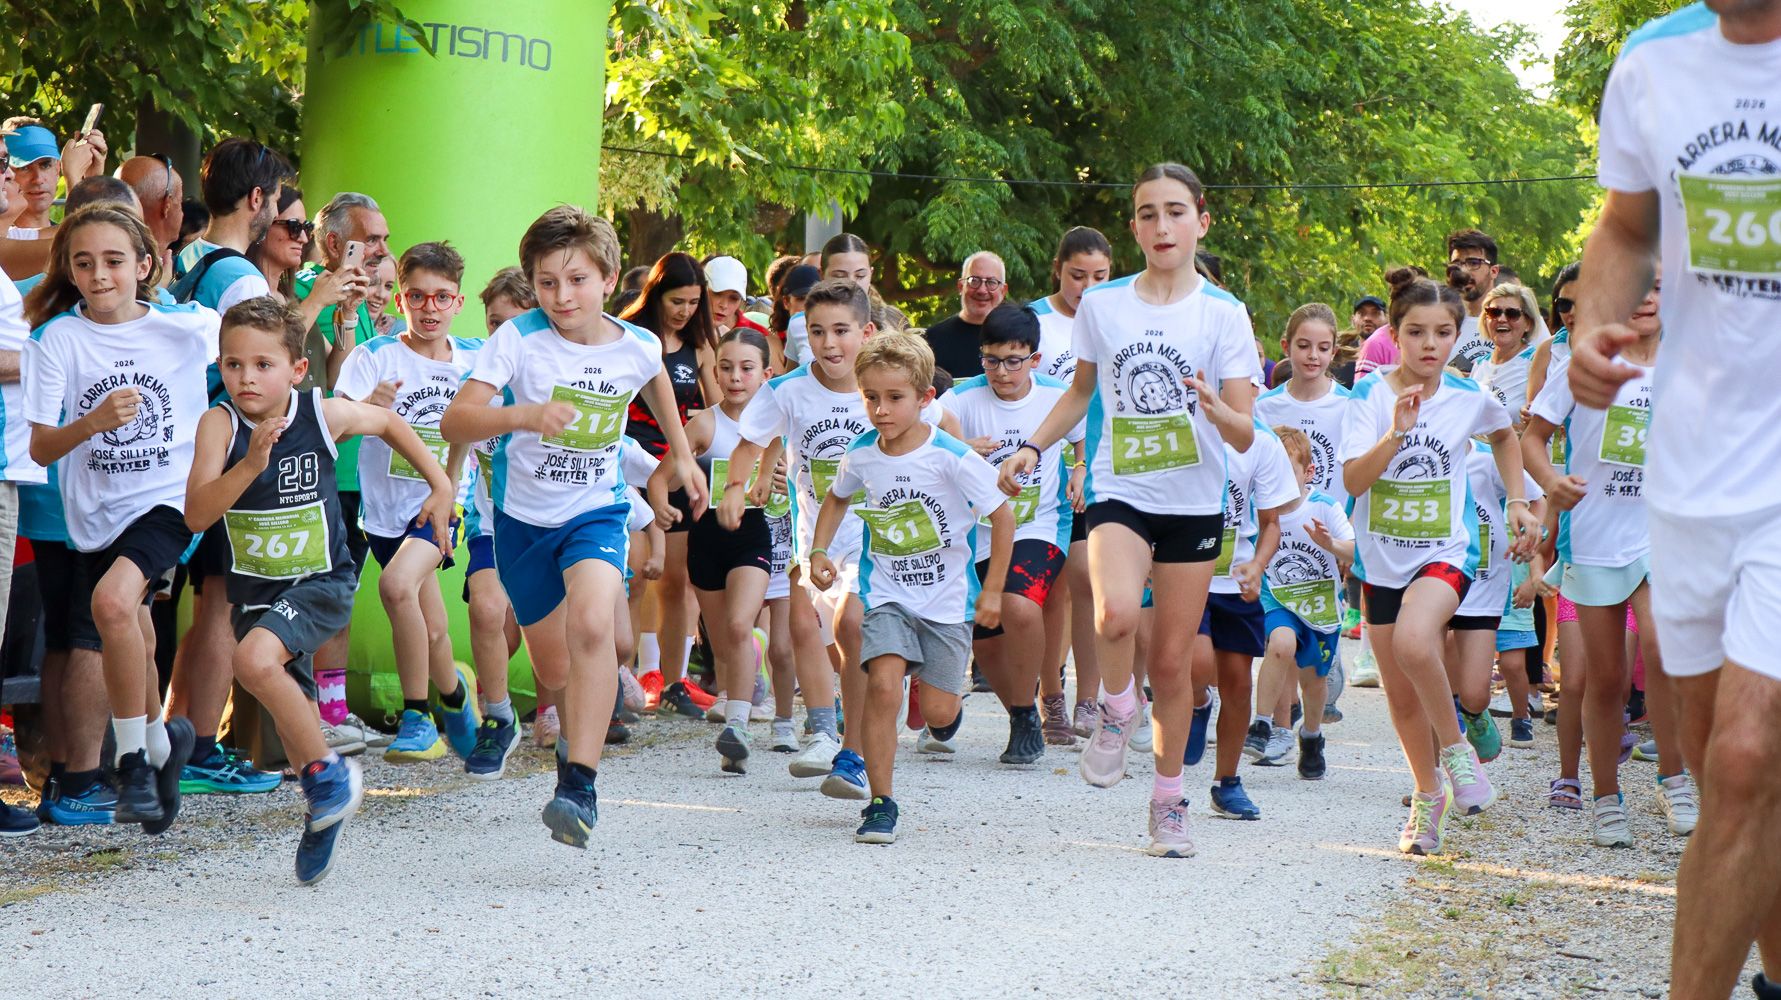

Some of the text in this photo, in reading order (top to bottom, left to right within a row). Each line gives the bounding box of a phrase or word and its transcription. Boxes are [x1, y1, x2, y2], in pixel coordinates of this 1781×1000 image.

[1735, 99, 1766, 110] 2026
[1145, 329, 1164, 337] 2026
[114, 359, 135, 368] 2026
[584, 366, 602, 375] 2026
[1112, 341, 1154, 379] CARRERA
[79, 372, 173, 422] CARRERA MEMORIAL
[396, 385, 441, 417] CARRERA
[831, 406, 849, 414] 2026
[801, 417, 840, 449] CARRERA
[1124, 432, 1179, 459] 251
[1310, 430, 1335, 475] MEMORIAL
[101, 459, 151, 471] KEYTER
[278, 451, 319, 493] 28
[544, 453, 569, 469] JOSÉ
[1611, 466, 1633, 482] JOSÉ
[279, 491, 318, 505] NYC SPORTS
[909, 488, 950, 536] MEMORIAL
[1382, 498, 1440, 523] 253
[244, 530, 310, 559] 267
[911, 552, 941, 571] SILLERO
[1291, 540, 1333, 579] MEMORIAL
[902, 571, 935, 583] KEYTER
